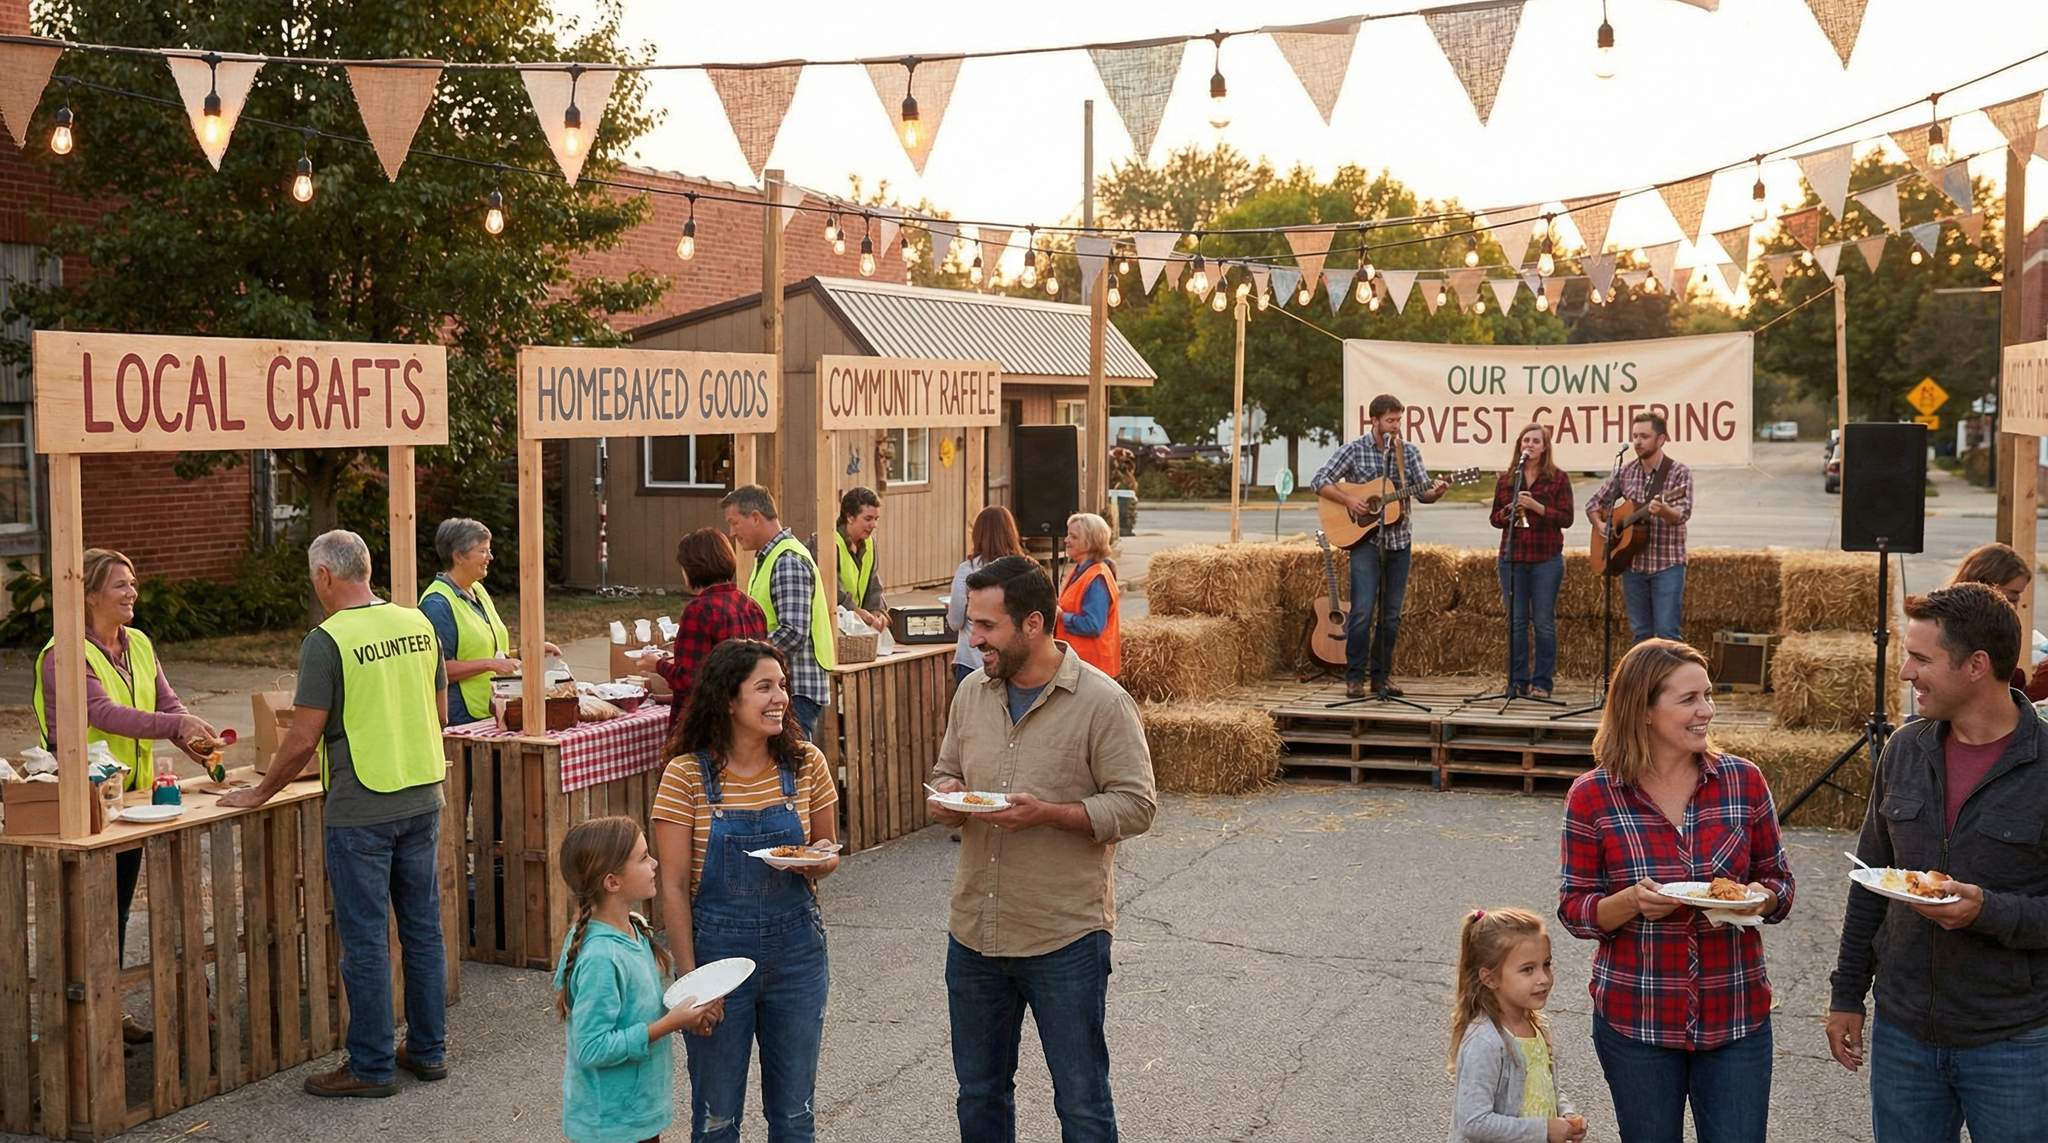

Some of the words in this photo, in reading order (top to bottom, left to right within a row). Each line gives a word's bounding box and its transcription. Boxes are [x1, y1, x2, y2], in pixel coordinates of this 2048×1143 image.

[83, 352, 246, 433] LOCAL
[266, 355, 426, 431] CRAFTS
[537, 366, 689, 421] HOMEBAKED
[699, 368, 769, 419] GOODS
[829, 367, 933, 417] COMMUNITY
[940, 369, 996, 415] RAFFLE
[1447, 365, 1507, 395] OUR
[1522, 361, 1638, 395] TOWN'S
[1359, 405, 1514, 444] RVEST
[353, 634, 432, 666] VOLUNTEER
